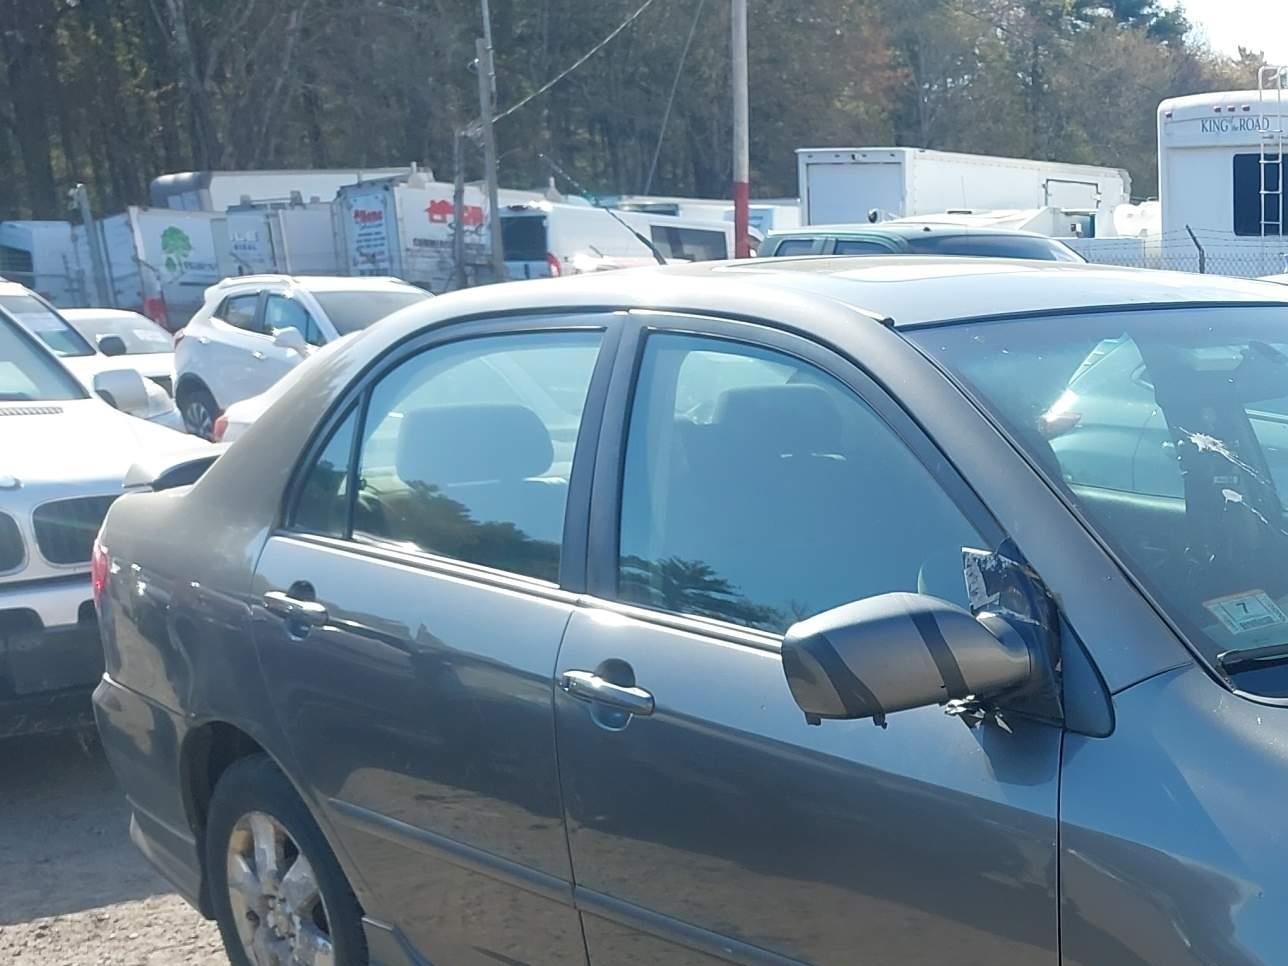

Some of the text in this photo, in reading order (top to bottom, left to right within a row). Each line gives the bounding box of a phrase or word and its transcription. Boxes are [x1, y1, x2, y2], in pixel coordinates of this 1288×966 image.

[1201, 118, 1229, 133] KING
[1239, 117, 1270, 131] ROAD
[1236, 602, 1249, 614] 7
